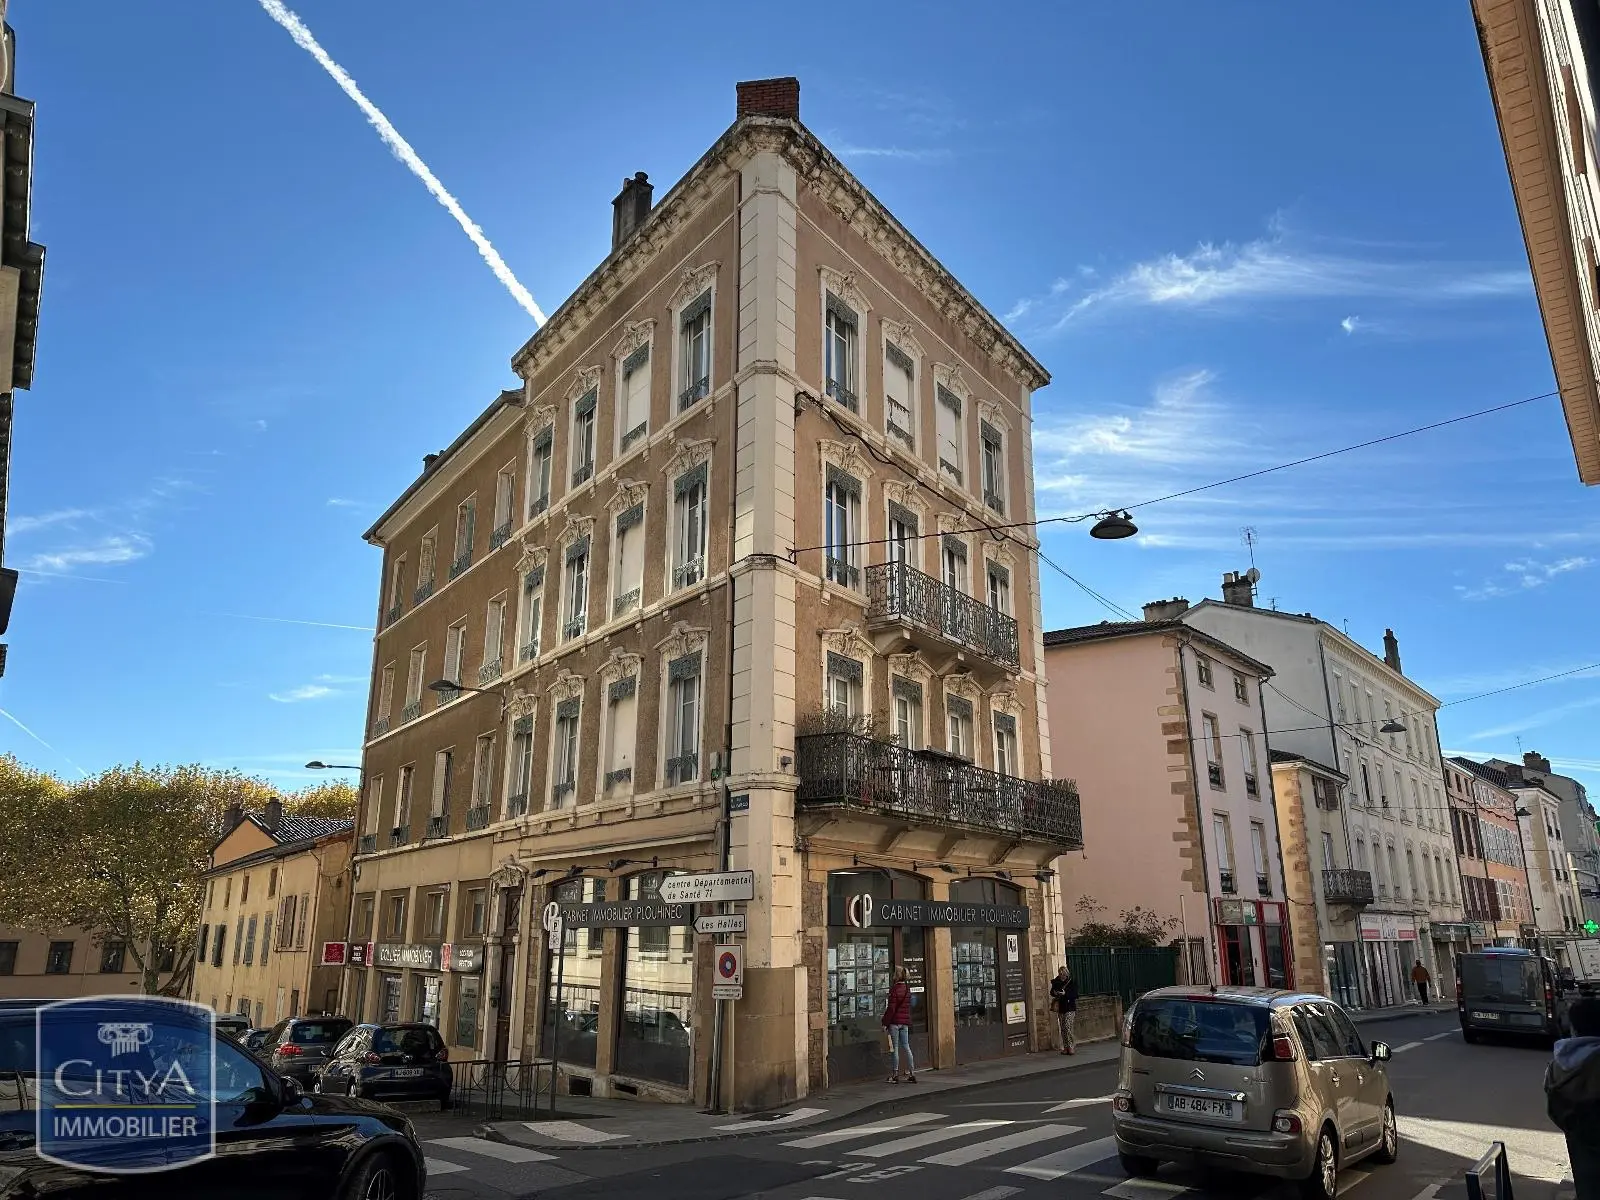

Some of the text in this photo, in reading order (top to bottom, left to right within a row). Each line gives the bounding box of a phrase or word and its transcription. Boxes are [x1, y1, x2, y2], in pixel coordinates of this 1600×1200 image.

[694, 874, 751, 889] Départemental
[667, 890, 676, 900] de
[680, 889, 700, 900] Santé
[562, 904, 683, 923] CABINET IMMOBILIER PLOUHINEC
[881, 904, 1022, 923] CABINET IMMOBILIER PLOUHINEC
[701, 919, 743, 930] Les Halles
